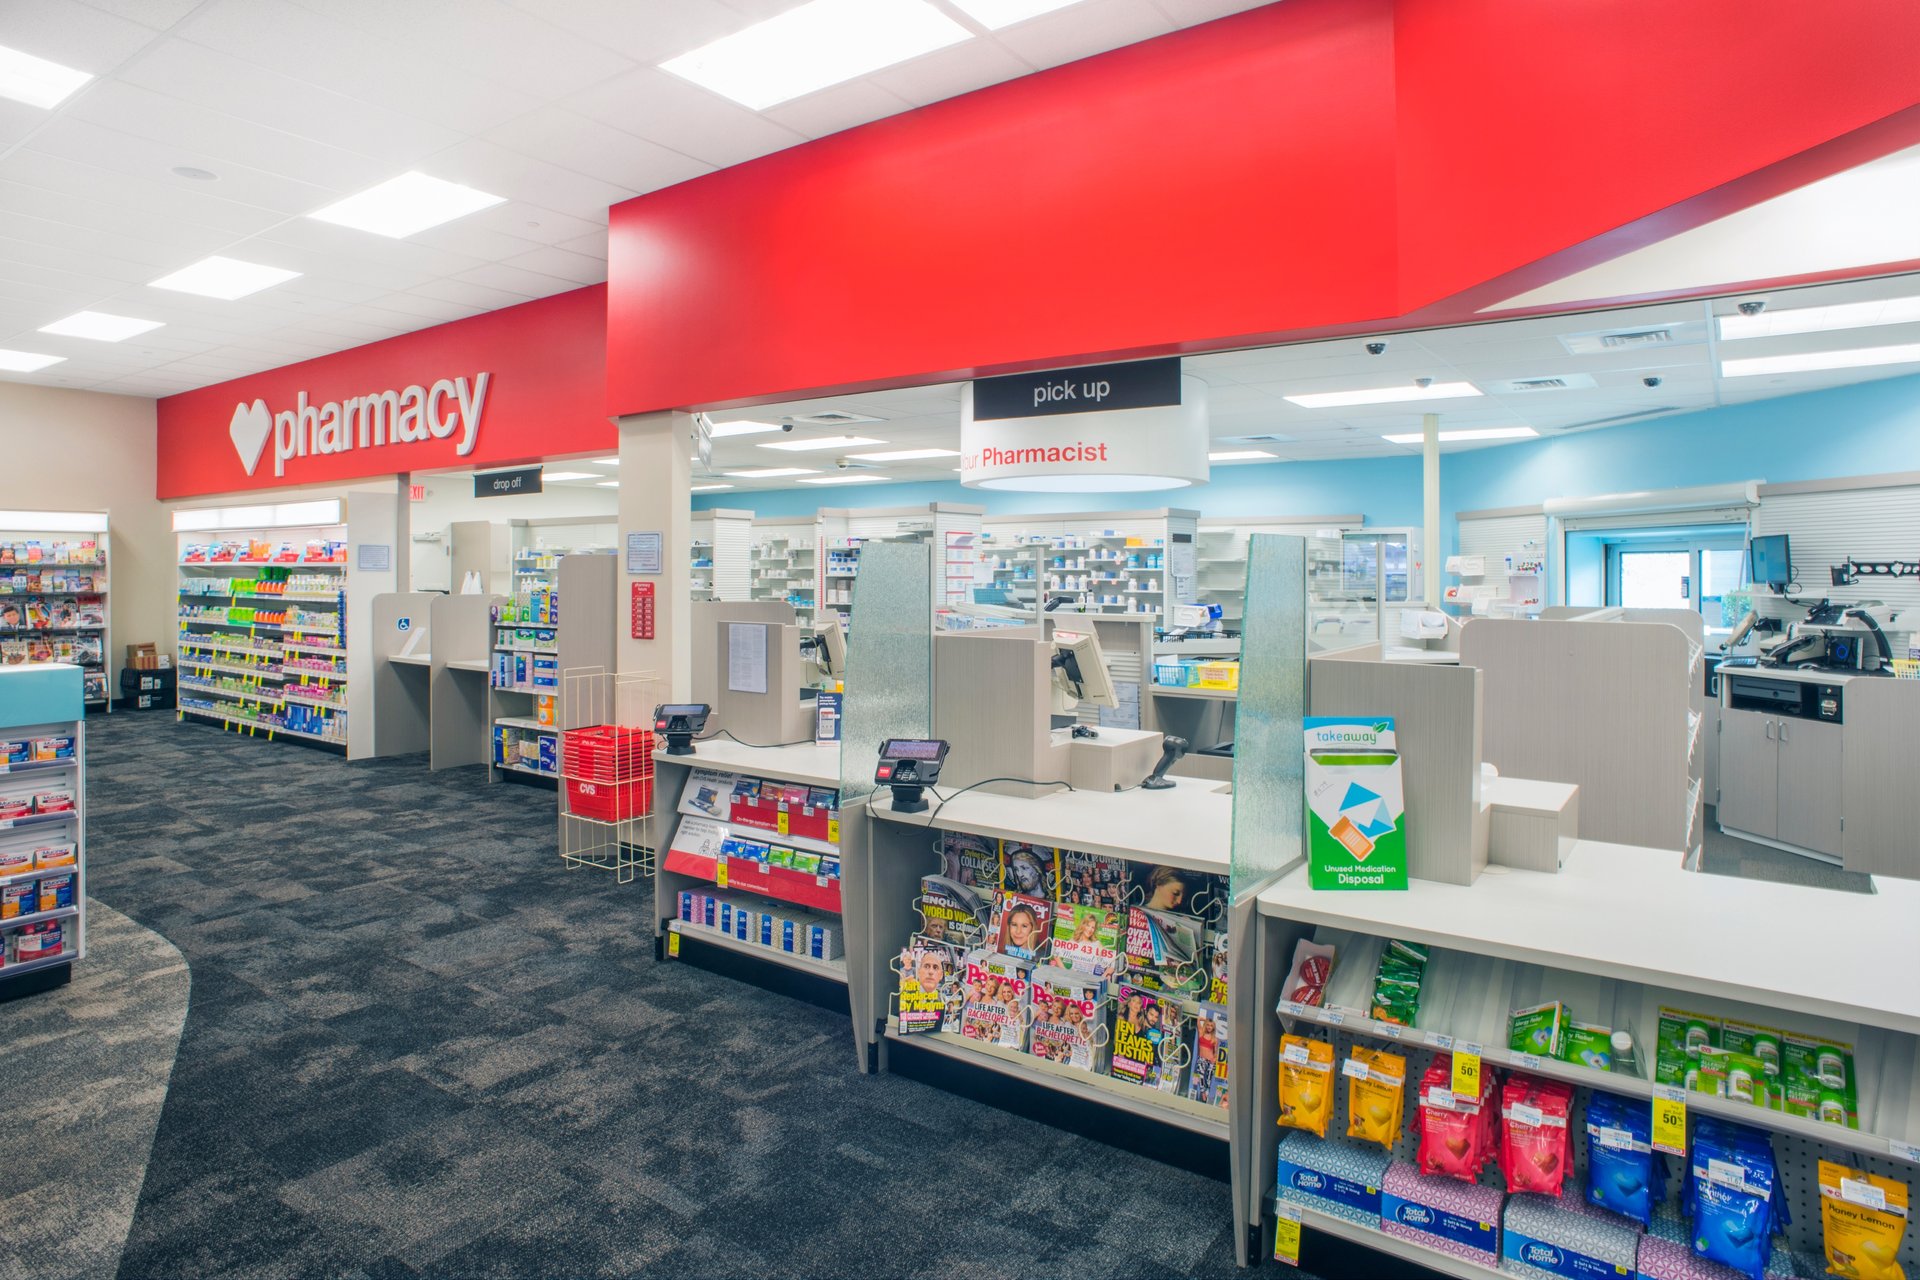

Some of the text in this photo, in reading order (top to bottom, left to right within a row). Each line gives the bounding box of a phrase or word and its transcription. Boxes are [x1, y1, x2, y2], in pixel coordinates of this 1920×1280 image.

[1034, 380, 1111, 408] pick up
[274, 372, 490, 477] pharmacy
[983, 442, 1108, 467] Pharmacist
[493, 476, 522, 491] drop off
[1317, 731, 1377, 744] takeaway
[580, 783, 596, 795] CVS
[1325, 865, 1396, 873] Unused Medication
[1338, 874, 1384, 886] Disposal
[923, 905, 953, 920] WORLD
[1054, 939, 1079, 951] DROP
[1081, 945, 1092, 955] 43
[974, 1002, 1006, 1015] LIFE AFTER
[1042, 1021, 1075, 1035] LIFE AFTER
[1115, 1018, 1135, 1036] JEN
[1116, 1031, 1153, 1052] LEAVES
[1113, 1041, 1154, 1066] JUSTIN!
[1303, 1069, 1322, 1078] Lemon
[1373, 1082, 1393, 1092] Lemon
[1425, 1108, 1448, 1119] Cherry
[1509, 1121, 1533, 1132] Cherry
[1299, 1173, 1318, 1182] Total
[1297, 1180, 1322, 1189] Home
[1404, 1206, 1426, 1217] Total
[1828, 1203, 1858, 1219] Honey
[1860, 1212, 1895, 1230] Lemon
[1403, 1214, 1430, 1223] Home
[1529, 1245, 1554, 1257] Total
[1528, 1254, 1558, 1264] Home
